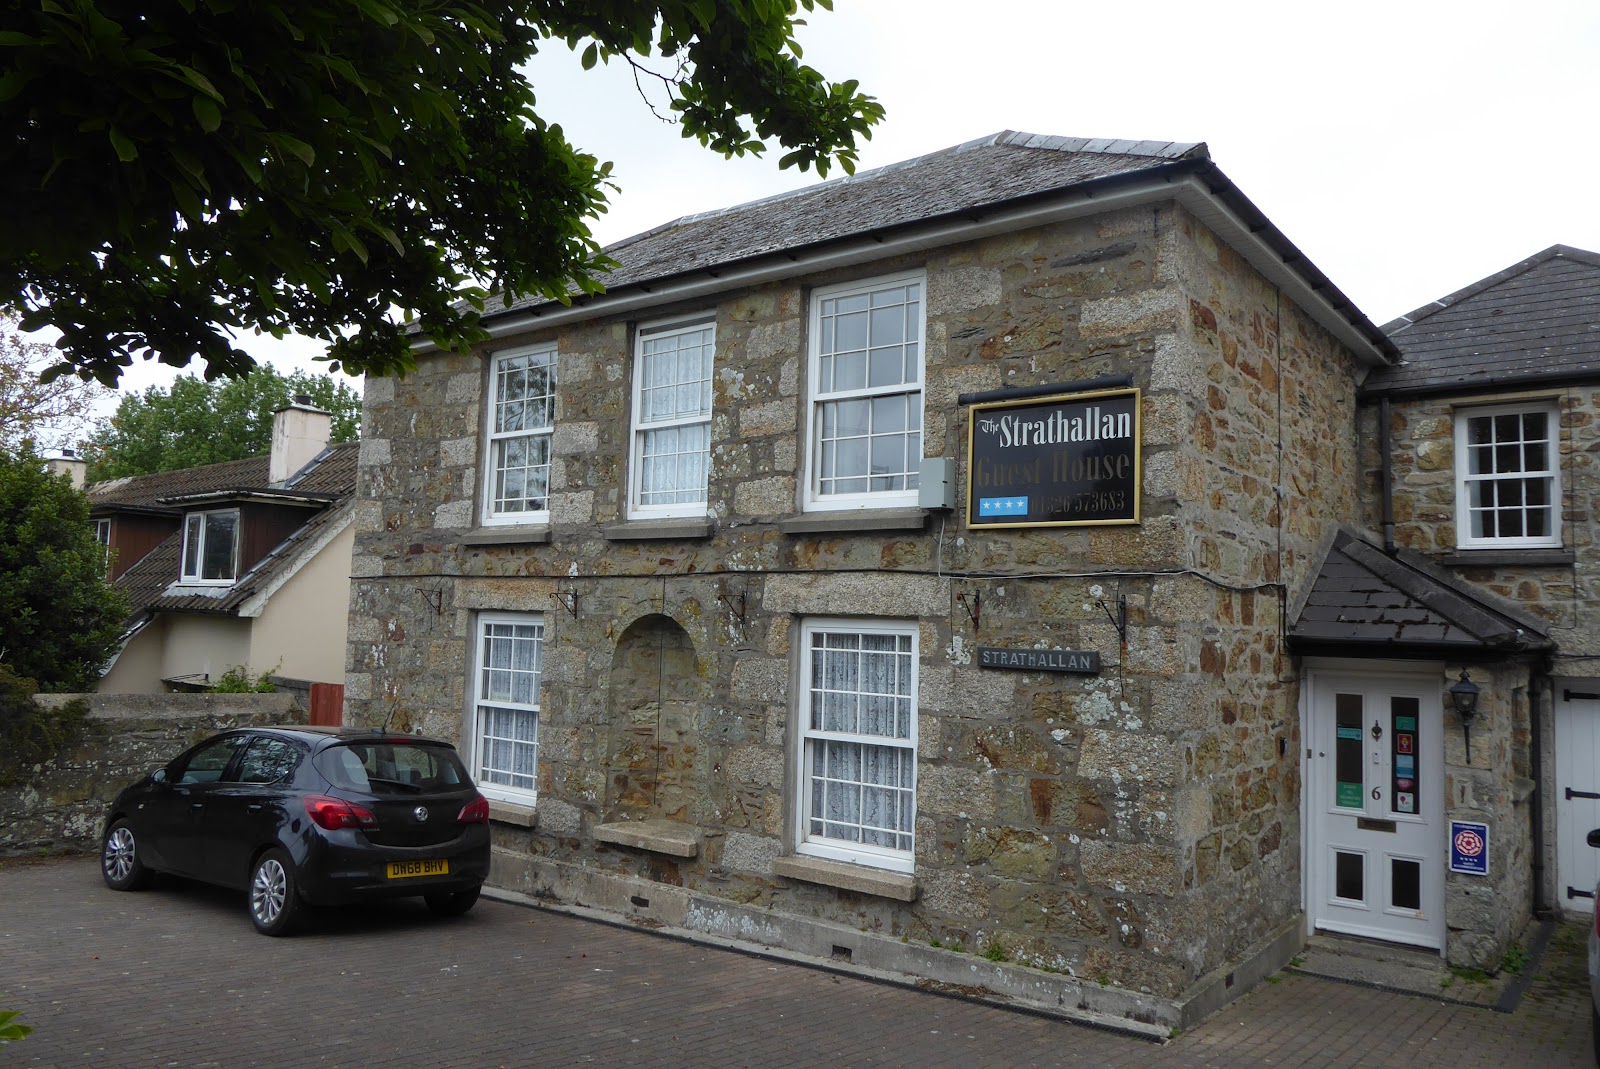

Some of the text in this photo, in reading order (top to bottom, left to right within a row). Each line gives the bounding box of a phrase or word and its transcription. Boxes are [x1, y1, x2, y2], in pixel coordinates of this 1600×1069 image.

[976, 406, 1132, 448] The Strathallan
[977, 450, 1130, 488] Guest House
[1031, 490, 1125, 514] 01326 573683
[982, 650, 1091, 669] STRATHALLAN
[1371, 786, 1382, 801] 6
[424, 860, 443, 873] BHV
